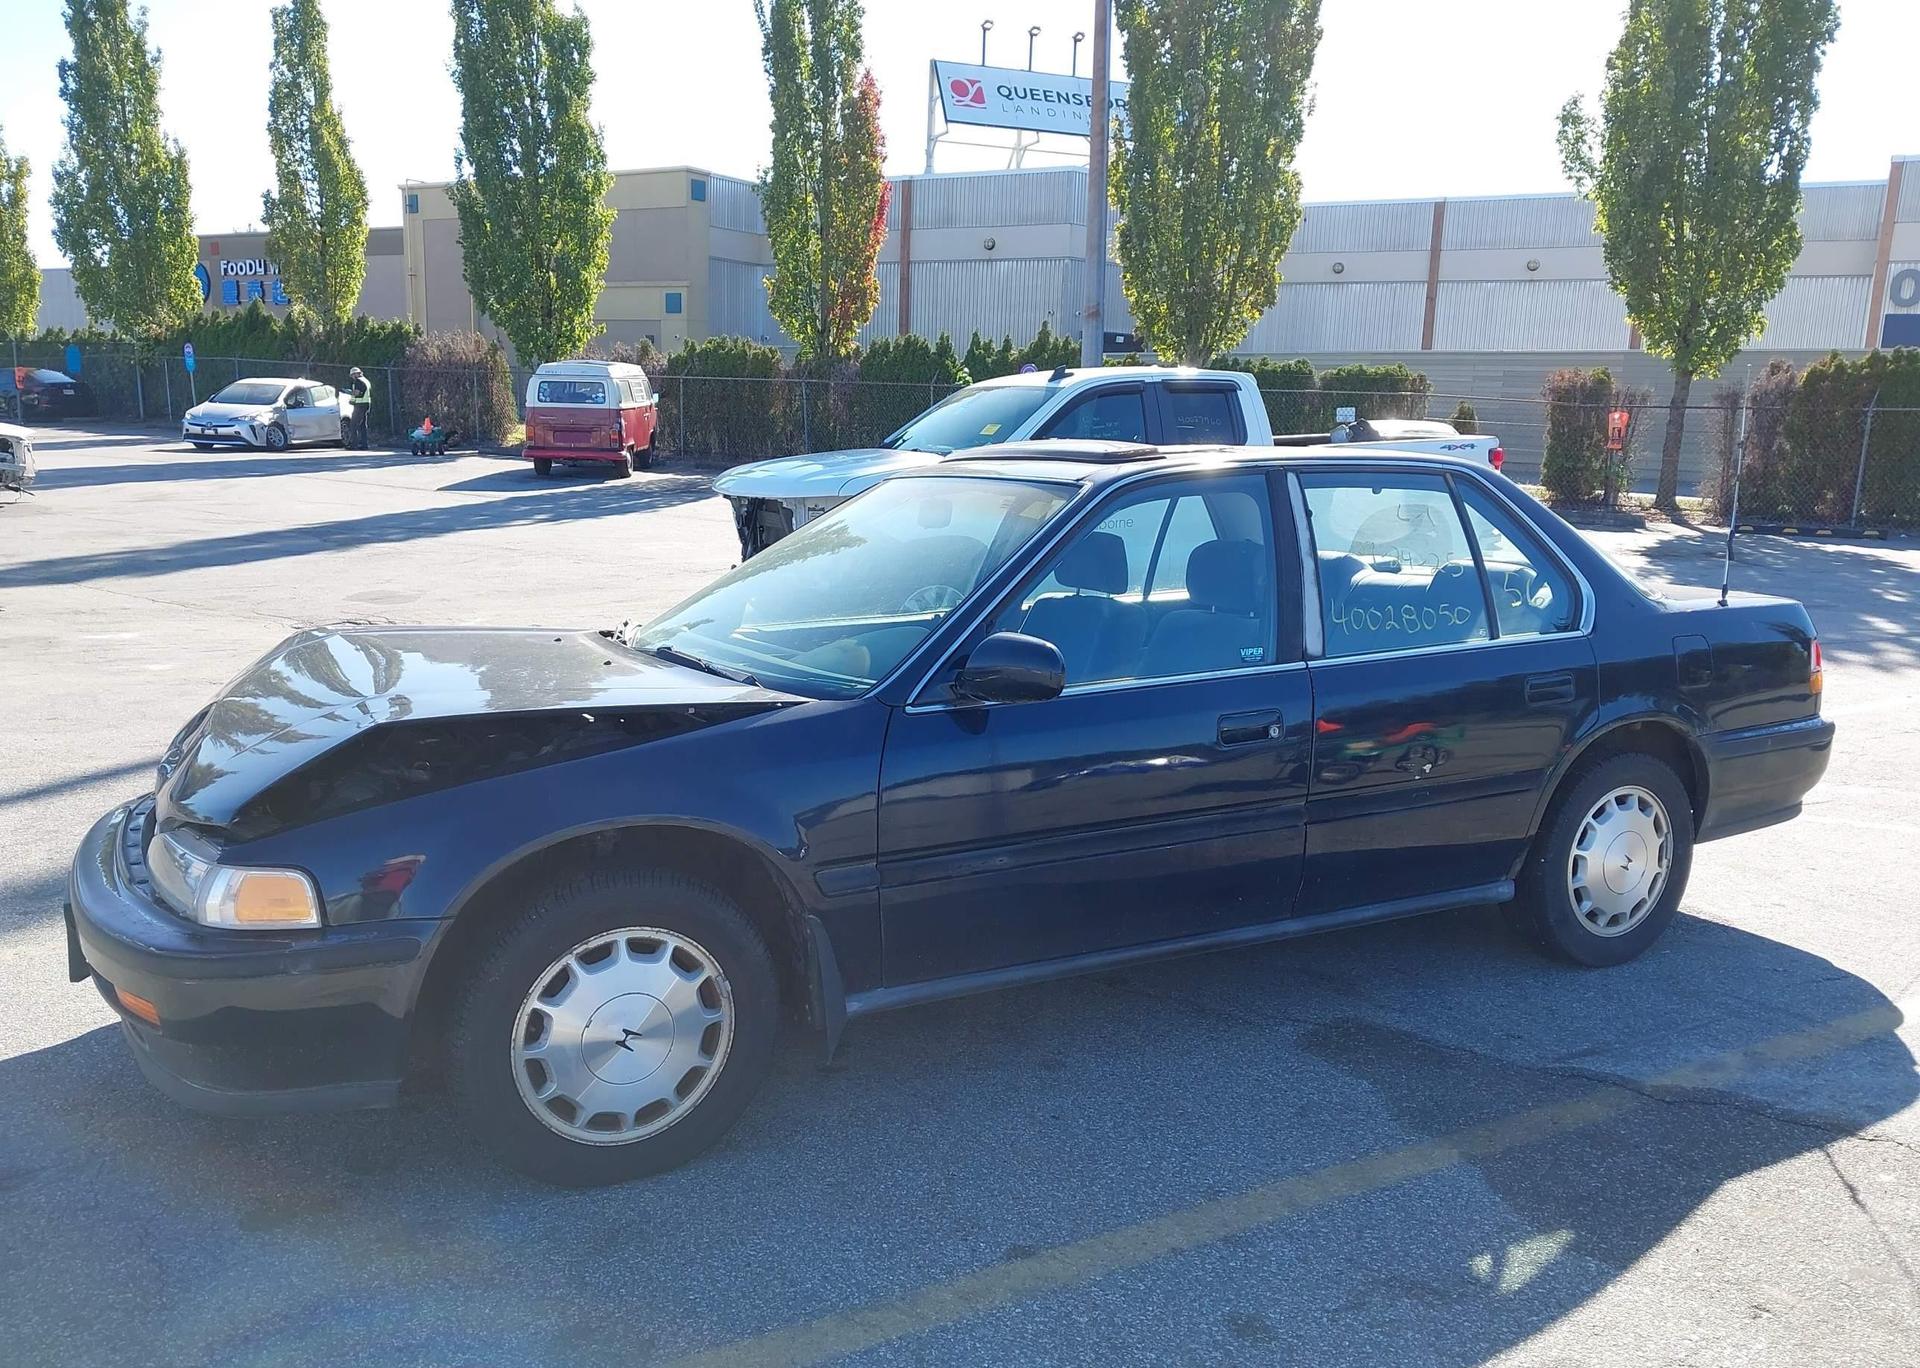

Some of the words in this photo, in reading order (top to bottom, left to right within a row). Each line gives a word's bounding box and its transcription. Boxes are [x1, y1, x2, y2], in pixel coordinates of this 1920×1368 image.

[1001, 103, 1092, 121] LANDIN
[1331, 598, 1472, 635] 40028050
[1240, 647, 1264, 656] VIPER
